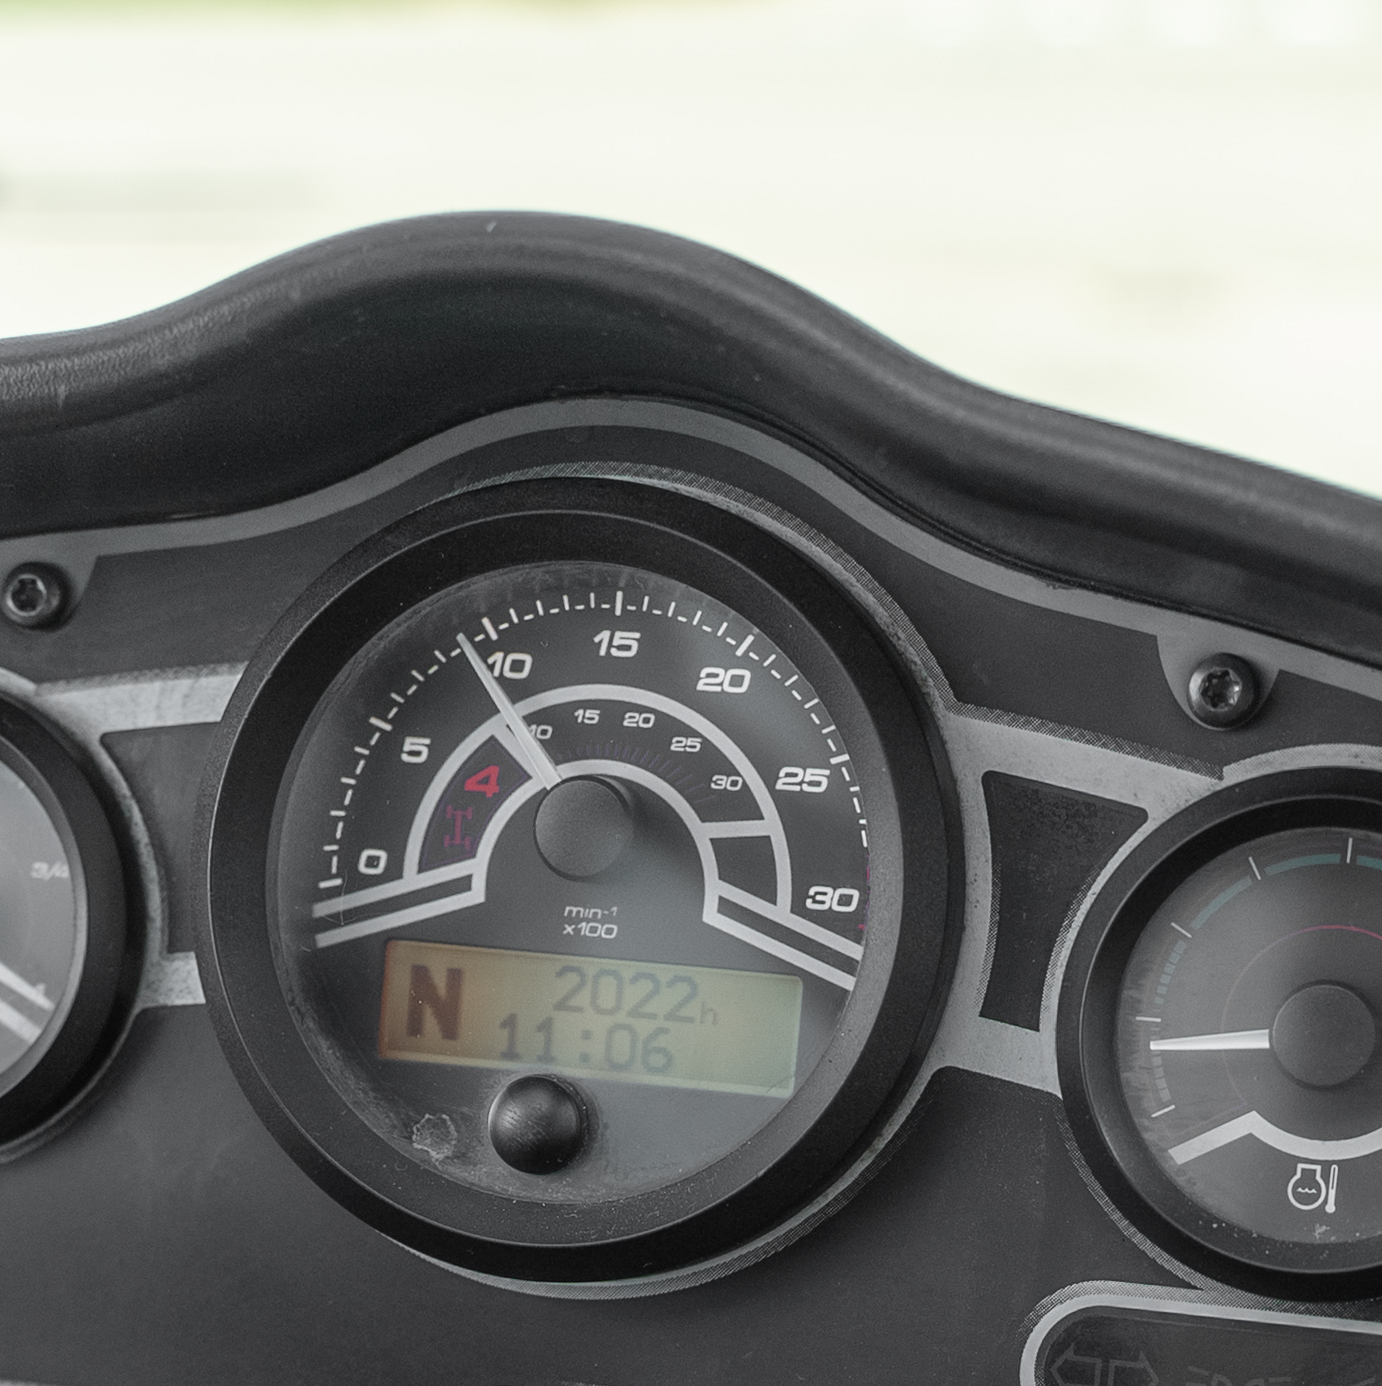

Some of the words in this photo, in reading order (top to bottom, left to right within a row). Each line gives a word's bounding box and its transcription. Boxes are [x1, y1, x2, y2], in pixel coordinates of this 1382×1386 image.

[592, 630, 641, 658] 15
[486, 651, 533, 679] 10
[696, 667, 752, 694] 20
[573, 709, 600, 725] 15
[622, 712, 656, 729] 20
[401, 737, 430, 763] 5
[670, 737, 703, 753] 25
[464, 764, 501, 797] 4
[710, 775, 743, 792] 30
[775, 767, 831, 793] 25
[358, 849, 387, 874] 0
[805, 886, 860, 912] 30
[406, 964, 464, 1041] N
[499, 1012, 674, 1074] 11:06
